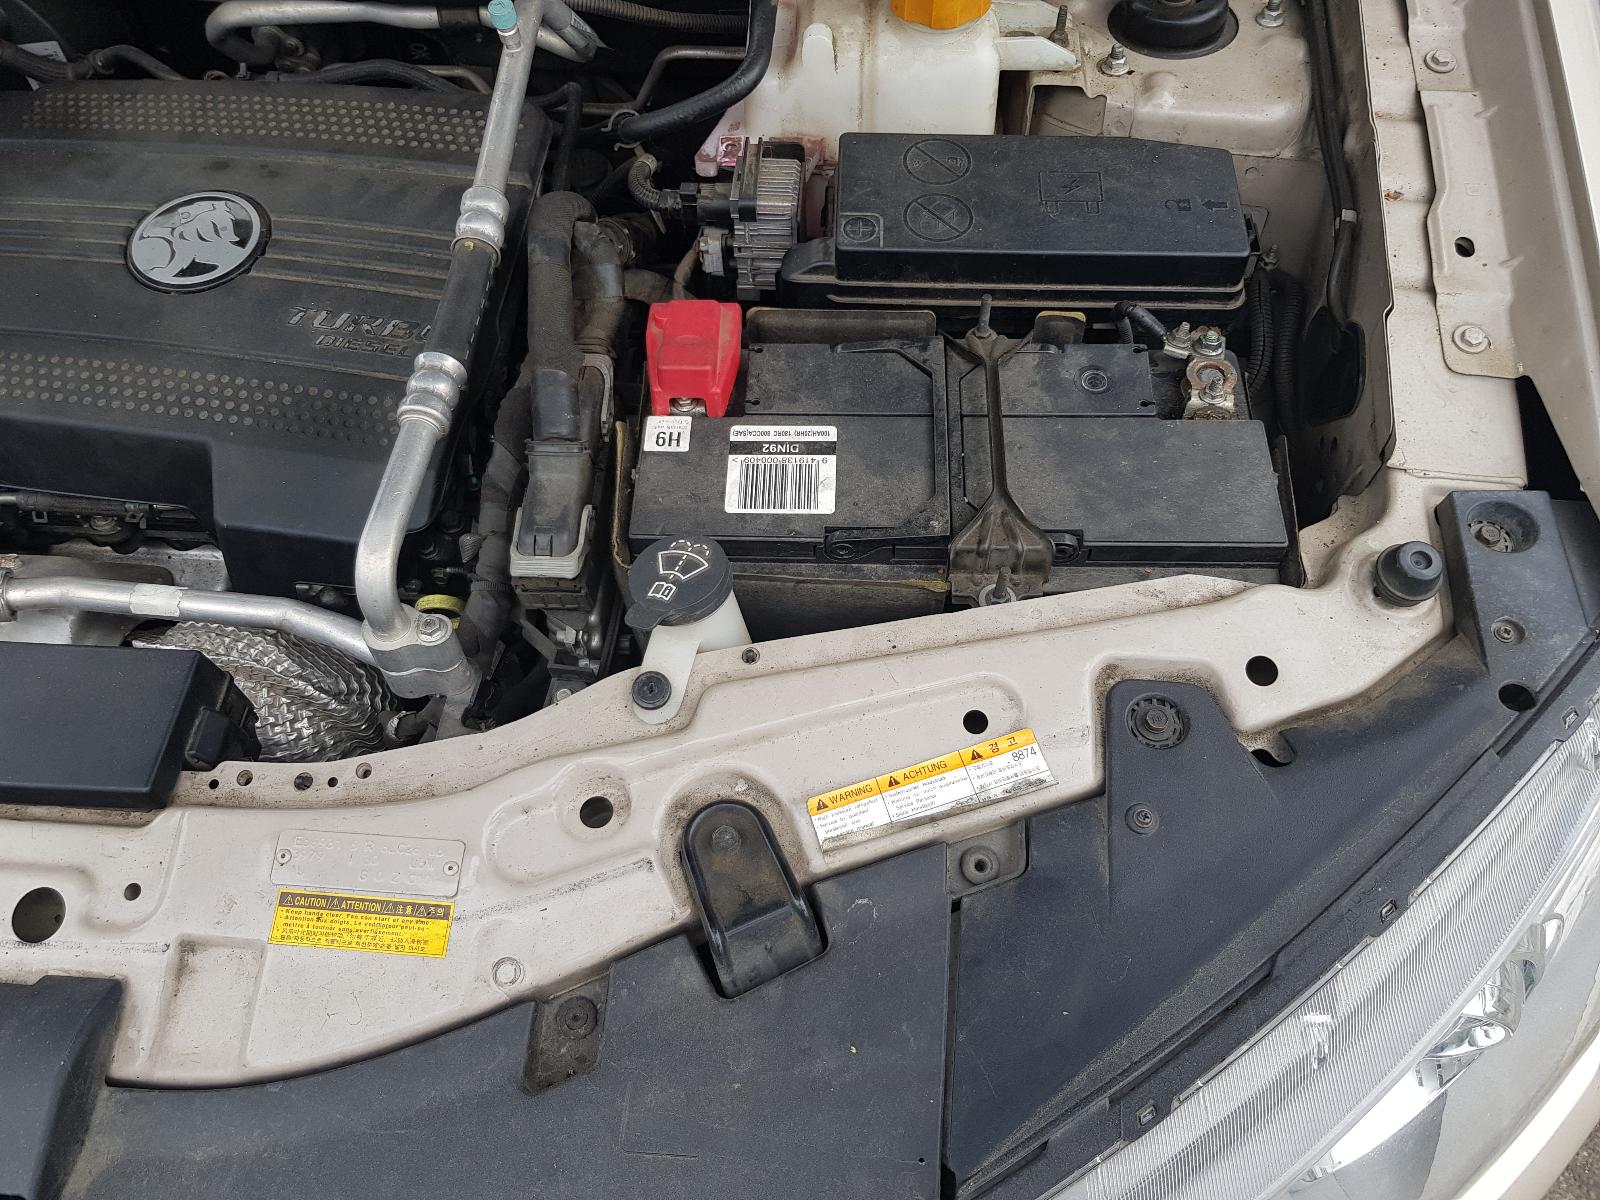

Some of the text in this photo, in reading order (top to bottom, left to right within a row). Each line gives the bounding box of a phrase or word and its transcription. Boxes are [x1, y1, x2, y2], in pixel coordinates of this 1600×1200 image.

[315, 334, 412, 357] DIESEL
[655, 431, 682, 448] H9
[762, 444, 799, 454] DIN92
[1011, 746, 1037, 762] 8874
[902, 760, 948, 782] ACHTUNG
[828, 783, 873, 805] WARNING
[294, 896, 382, 912] CAUTION ATTENTION
